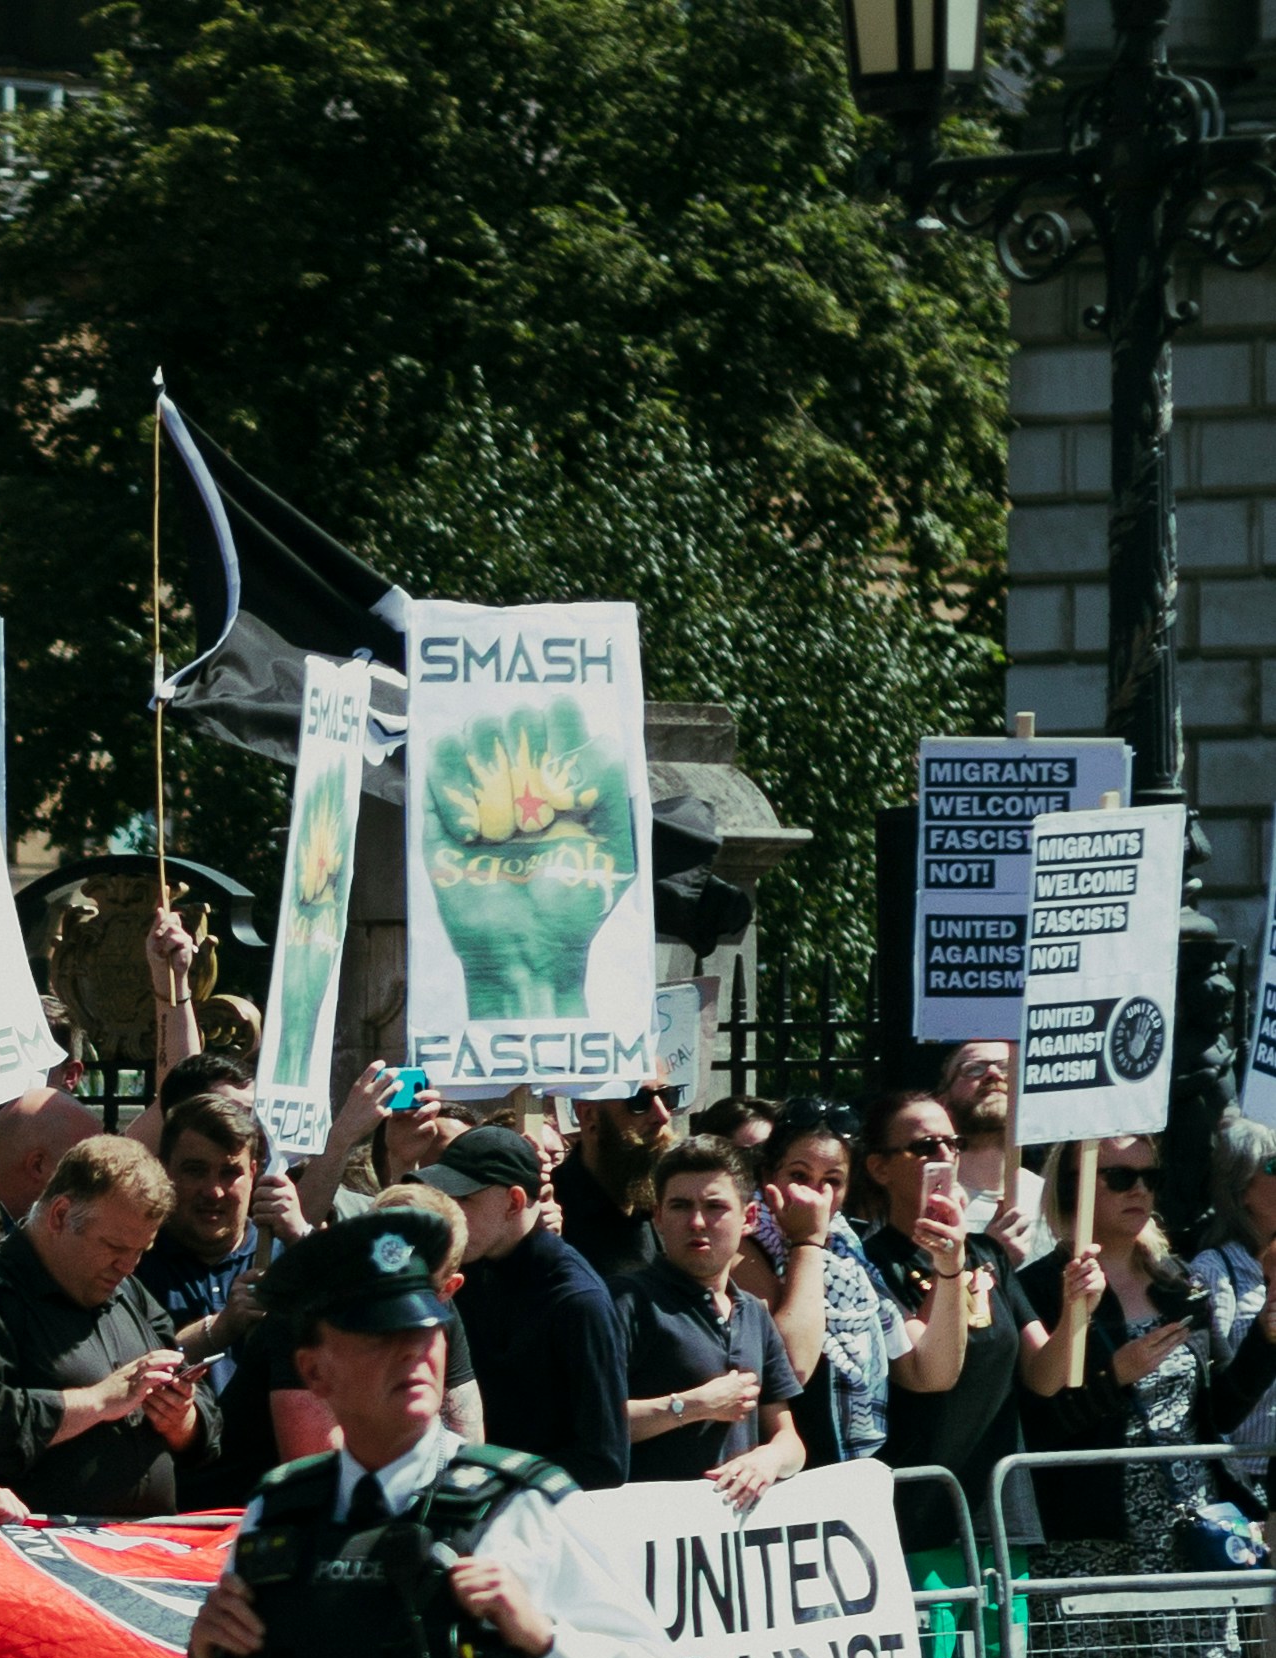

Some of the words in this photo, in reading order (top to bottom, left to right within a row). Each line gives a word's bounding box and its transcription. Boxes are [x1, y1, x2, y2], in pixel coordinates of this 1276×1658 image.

[419, 632, 613, 684] SMASH
[307, 686, 362, 747] SMASH
[929, 762, 1071, 784] MIGRANTS
[929, 795, 1065, 816] WELCOME
[1039, 831, 1142, 862] MIGRANTS
[929, 863, 990, 883] NOT!
[1036, 868, 1137, 898] WELCOME
[930, 919, 1017, 939] UNITED
[1033, 905, 1128, 934] FASCISTS
[929, 945, 1025, 965] AGAINS
[1030, 944, 1079, 970] NOT!
[930, 970, 1025, 990] RACISM
[1029, 1004, 1095, 1031] UNITED
[1124, 1002, 1163, 1031] UNITED
[414, 1029, 650, 1079] FASCISM
[1027, 1030, 1106, 1059] AGAINST
[1025, 1059, 1097, 1086] RACISM
[315, 1560, 385, 1580] POLICE
[645, 1519, 879, 1642] UNITED
